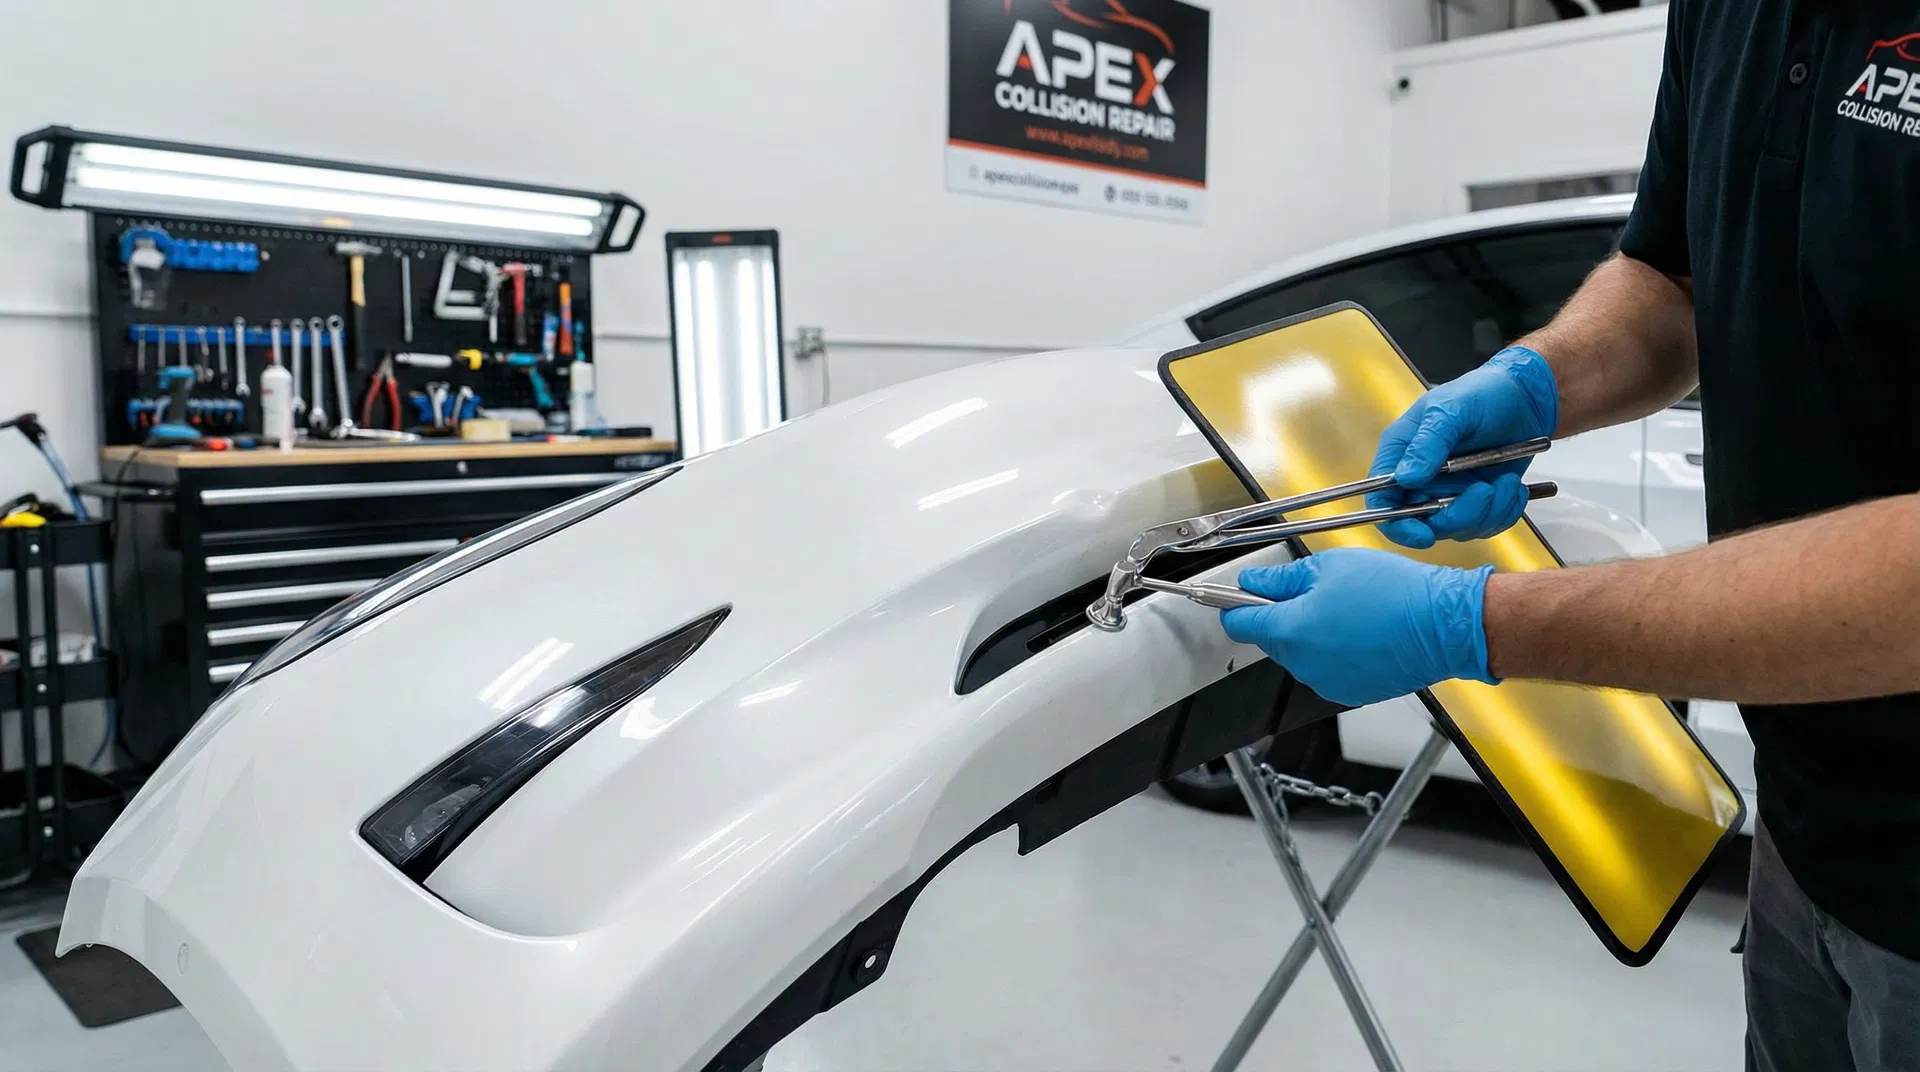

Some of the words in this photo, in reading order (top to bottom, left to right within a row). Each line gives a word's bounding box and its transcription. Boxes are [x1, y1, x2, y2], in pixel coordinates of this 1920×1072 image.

[995, 19, 1176, 115] APEX
[994, 81, 1106, 128] COLLISION
[1108, 106, 1176, 143] REPAIR
[1837, 100, 1902, 131] COLLISION
